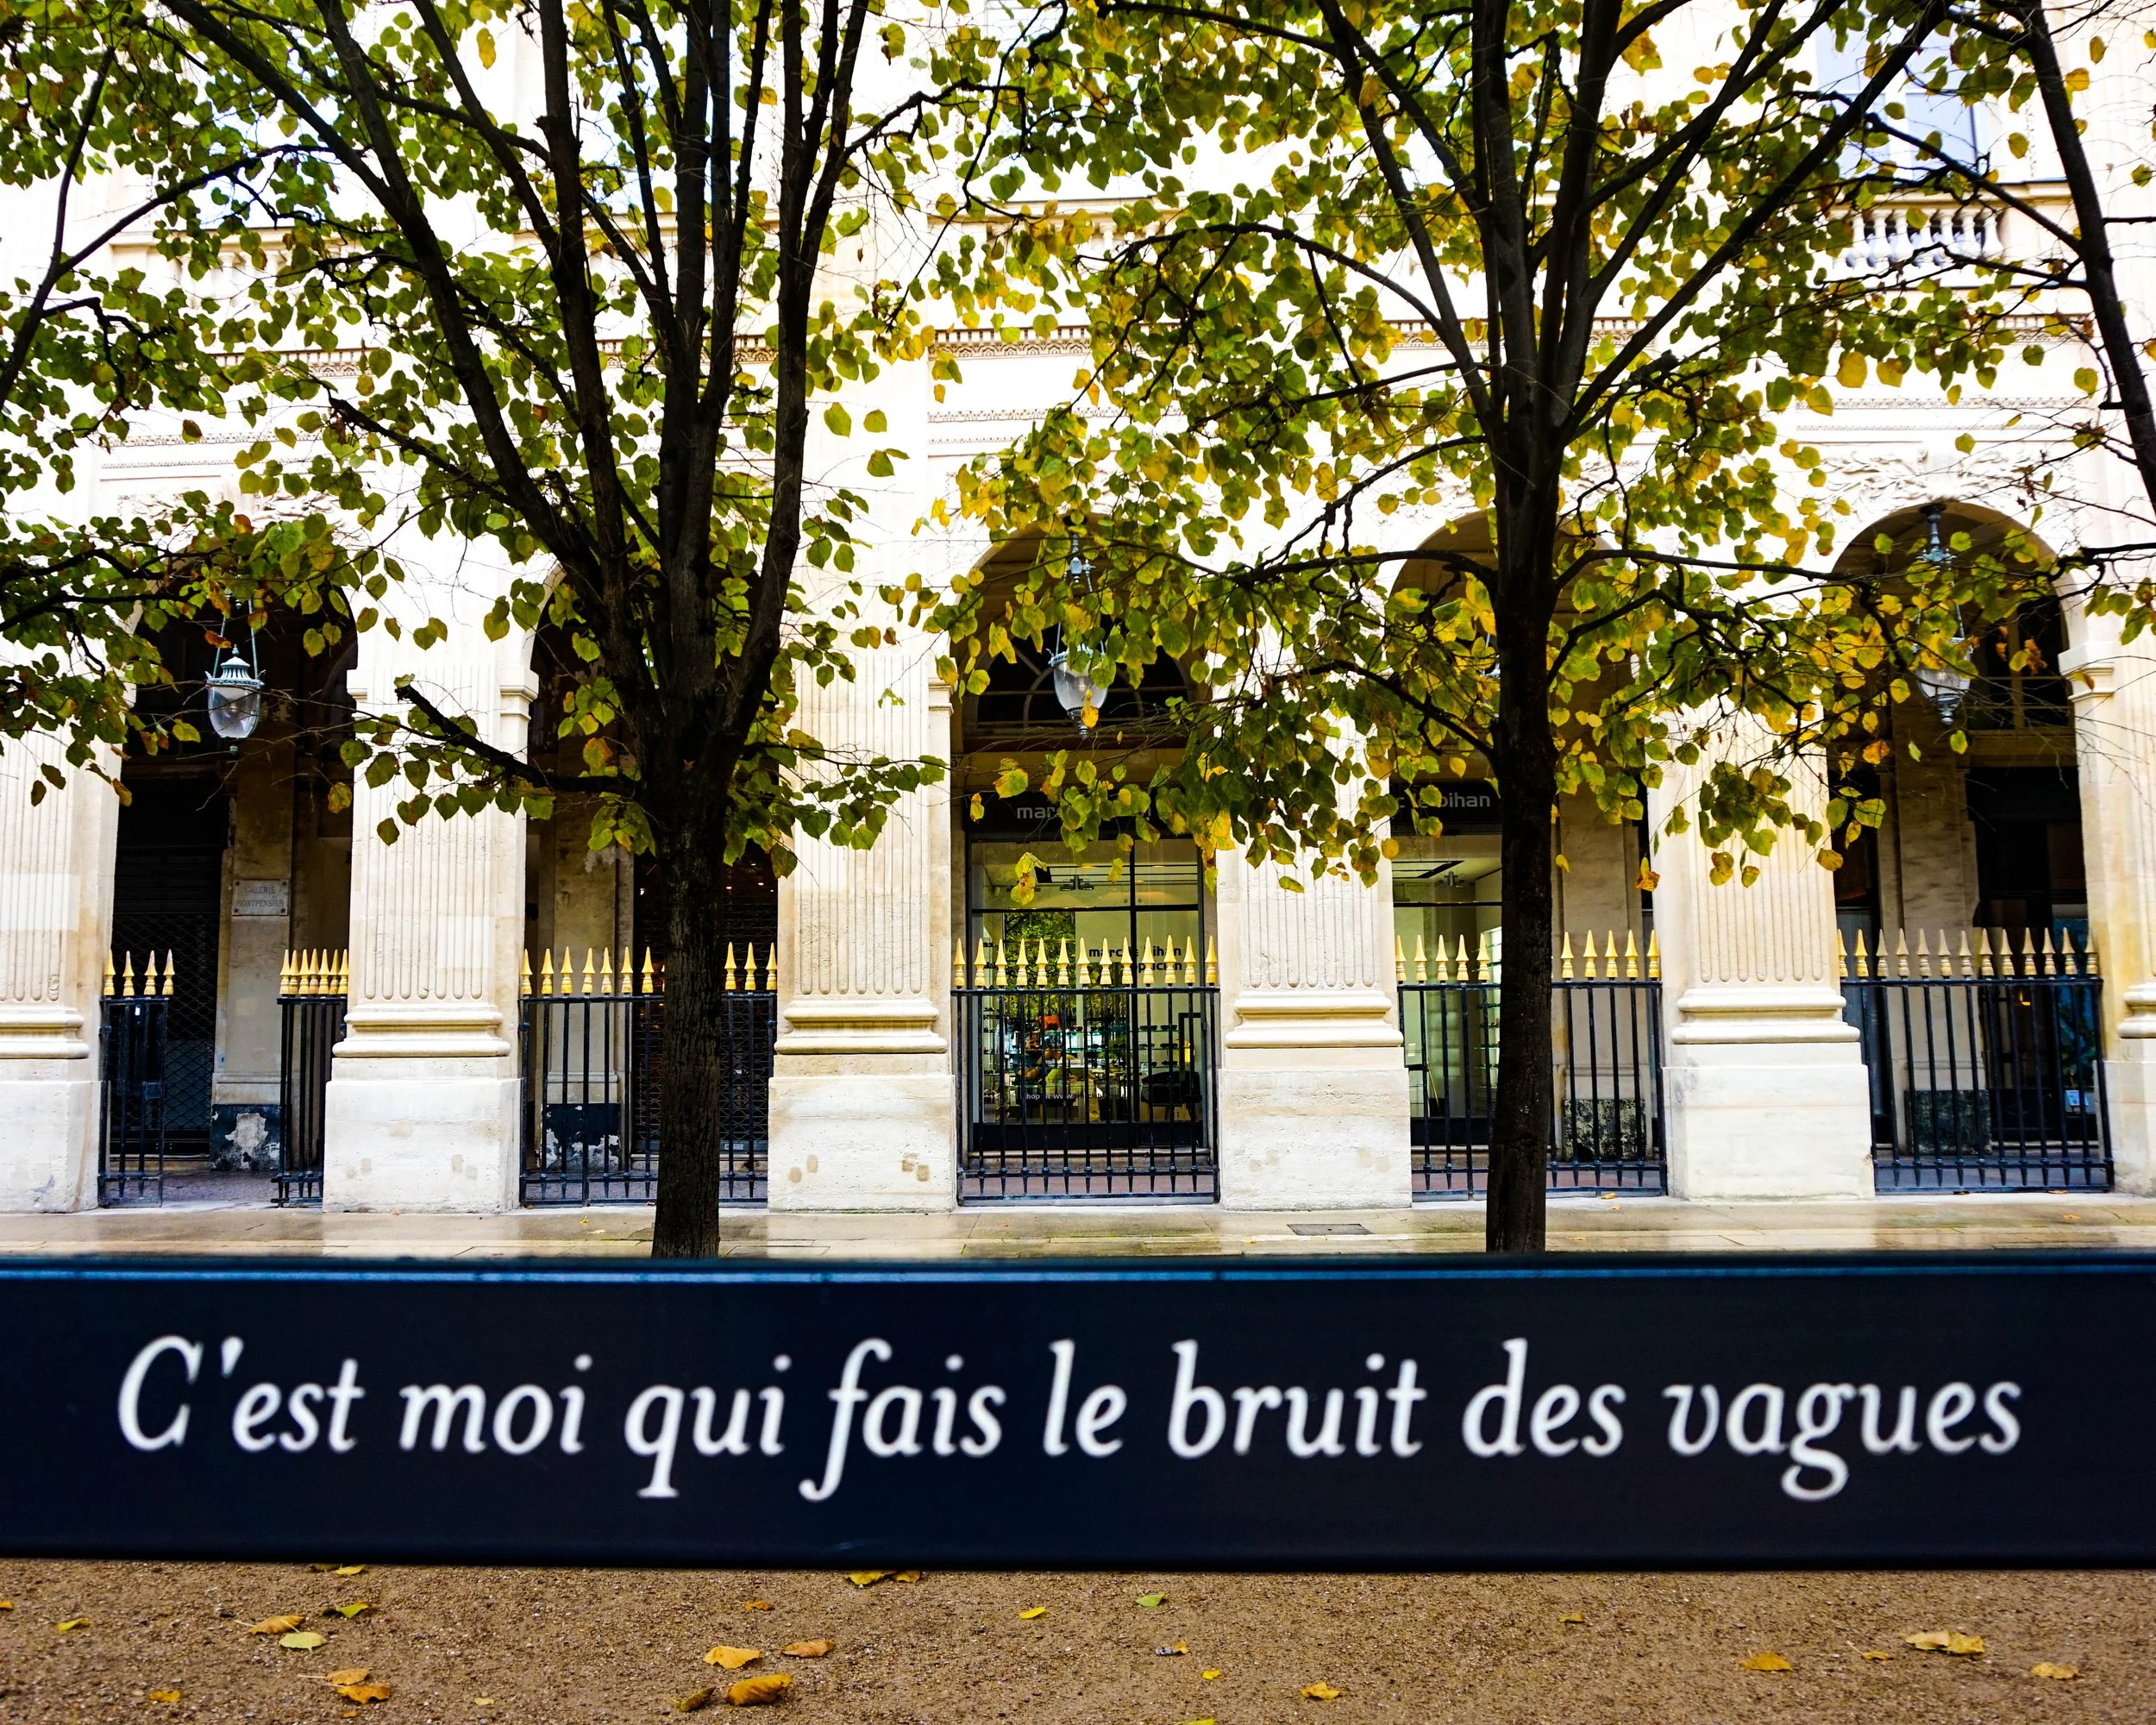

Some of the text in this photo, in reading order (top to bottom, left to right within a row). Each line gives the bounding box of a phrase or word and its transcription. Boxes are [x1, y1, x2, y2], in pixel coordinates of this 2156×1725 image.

[1016, 806, 1061, 819] mar
[244, 886, 276, 894] GALERIE
[236, 899, 285, 908] MONTPENSIER
[1088, 948, 1124, 957] mrc
[117, 1334, 2021, 1502] C'est moi qui fais le bruit des vagues
